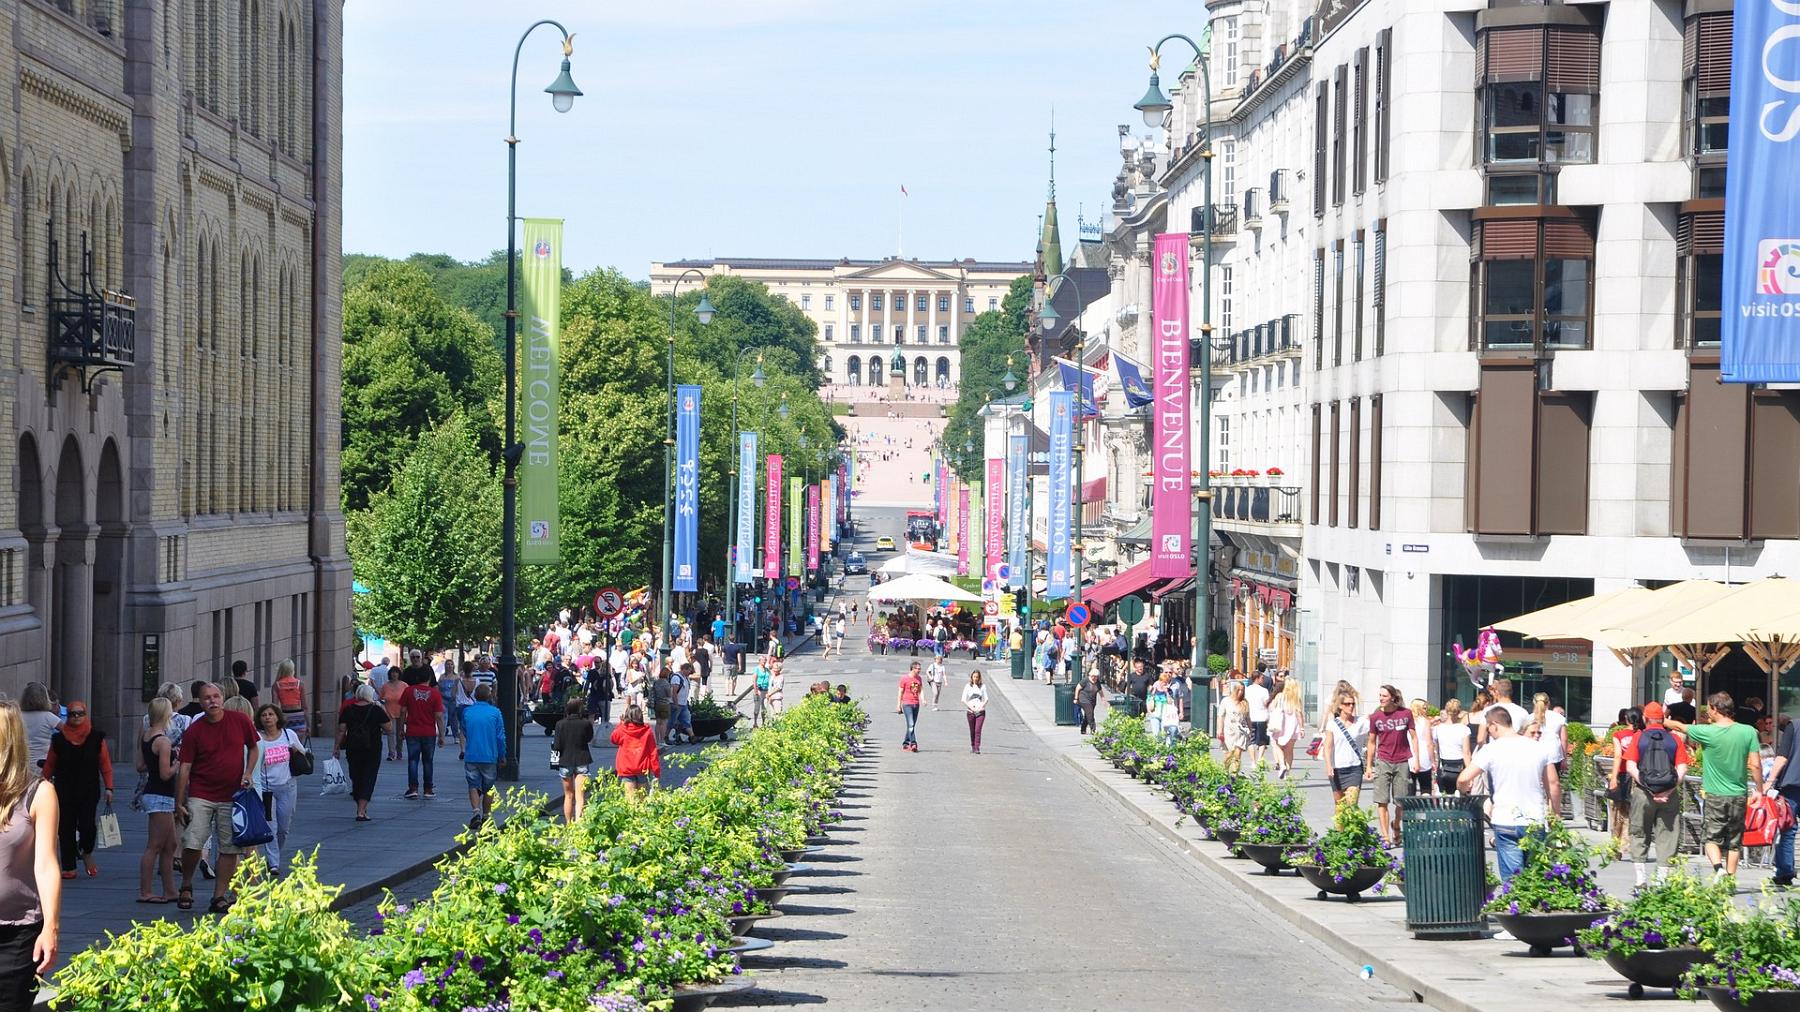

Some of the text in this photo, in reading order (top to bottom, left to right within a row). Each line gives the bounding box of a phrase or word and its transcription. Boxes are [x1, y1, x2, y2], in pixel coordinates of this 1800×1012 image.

[1760, 0, 1800, 143] OS
[1741, 301, 1779, 318] visit
[1159, 318, 1184, 493] BIENVENUE
[990, 481, 1001, 557] WILLKOMMEN
[1012, 468, 1024, 552] VELKOMMEN
[1052, 432, 1067, 554] BIENVENIDOS
